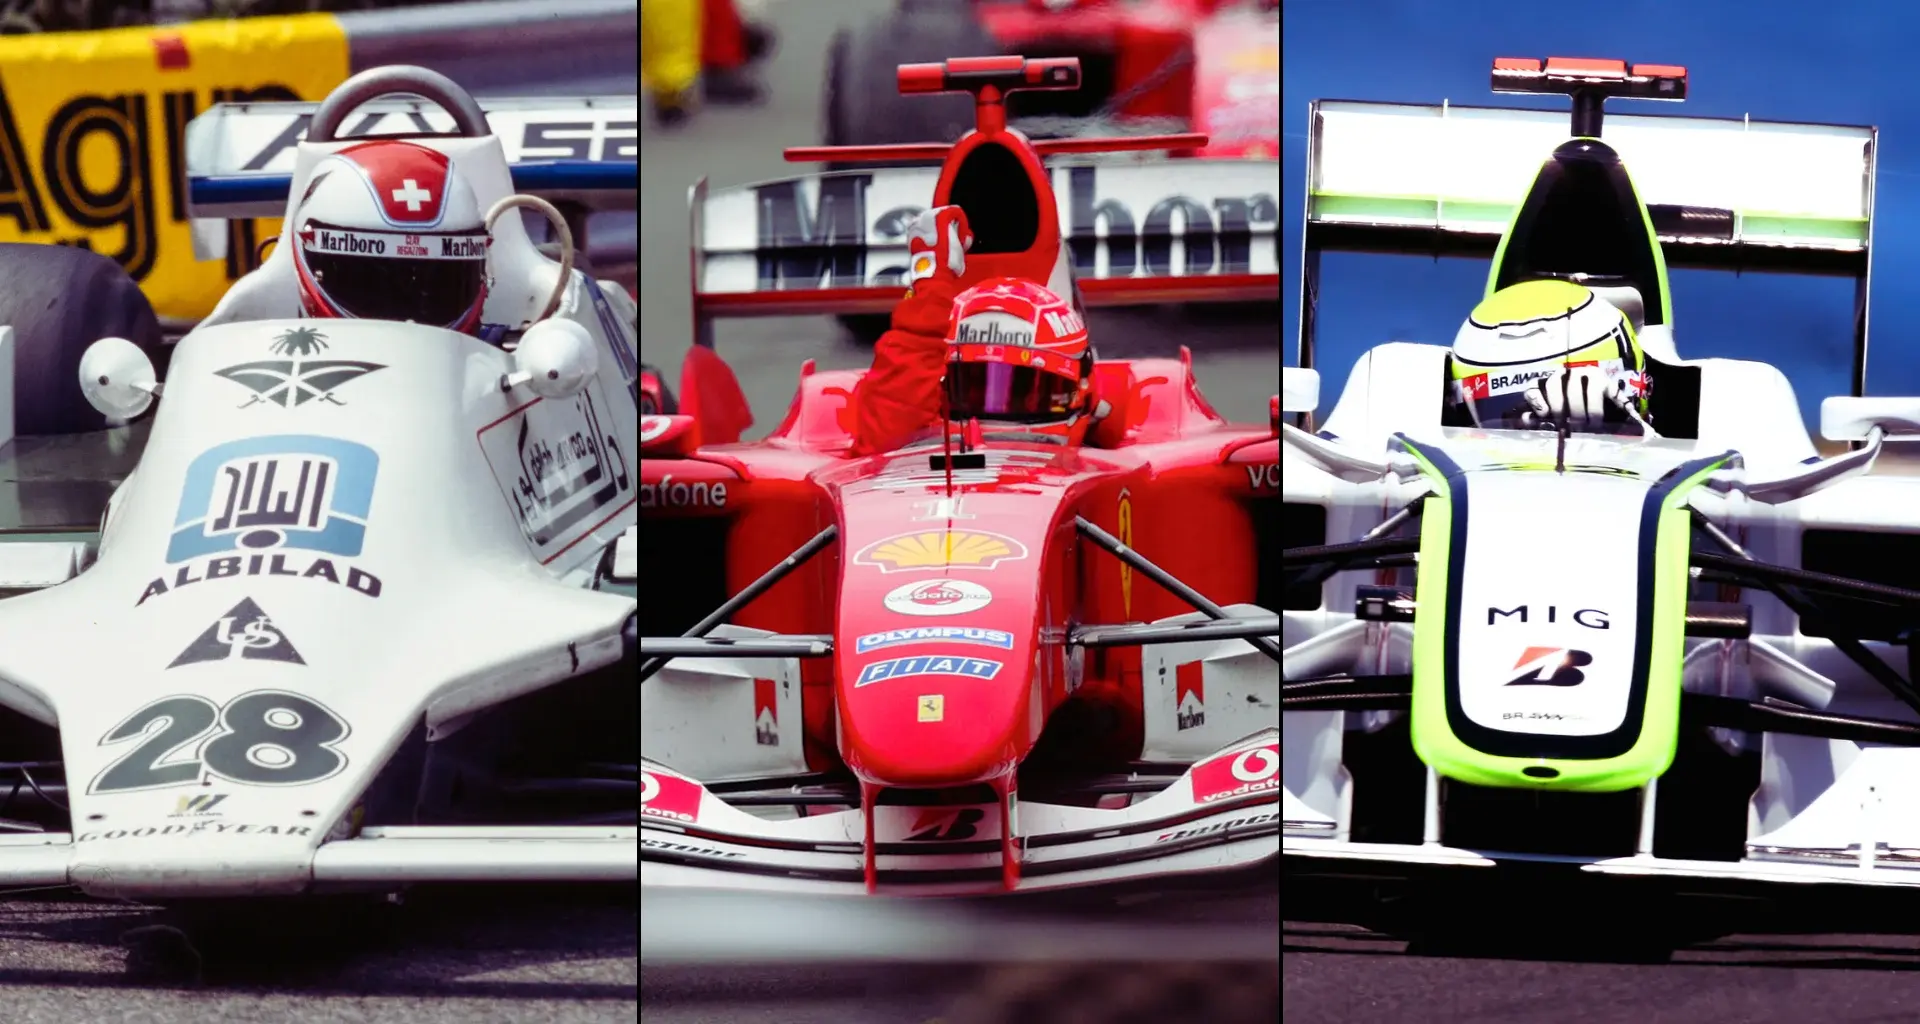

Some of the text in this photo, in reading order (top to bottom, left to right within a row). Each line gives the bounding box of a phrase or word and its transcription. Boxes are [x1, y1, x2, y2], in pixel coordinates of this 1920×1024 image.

[321, 231, 385, 256] Marlboro
[441, 238, 485, 256] Marlbor
[957, 321, 1032, 347] Marlboro
[134, 554, 382, 608] ALBILAD
[1488, 605, 1610, 630] MIG
[861, 627, 1009, 647] OLYMPUS
[867, 658, 992, 681] FIAT
[86, 689, 352, 795] 28
